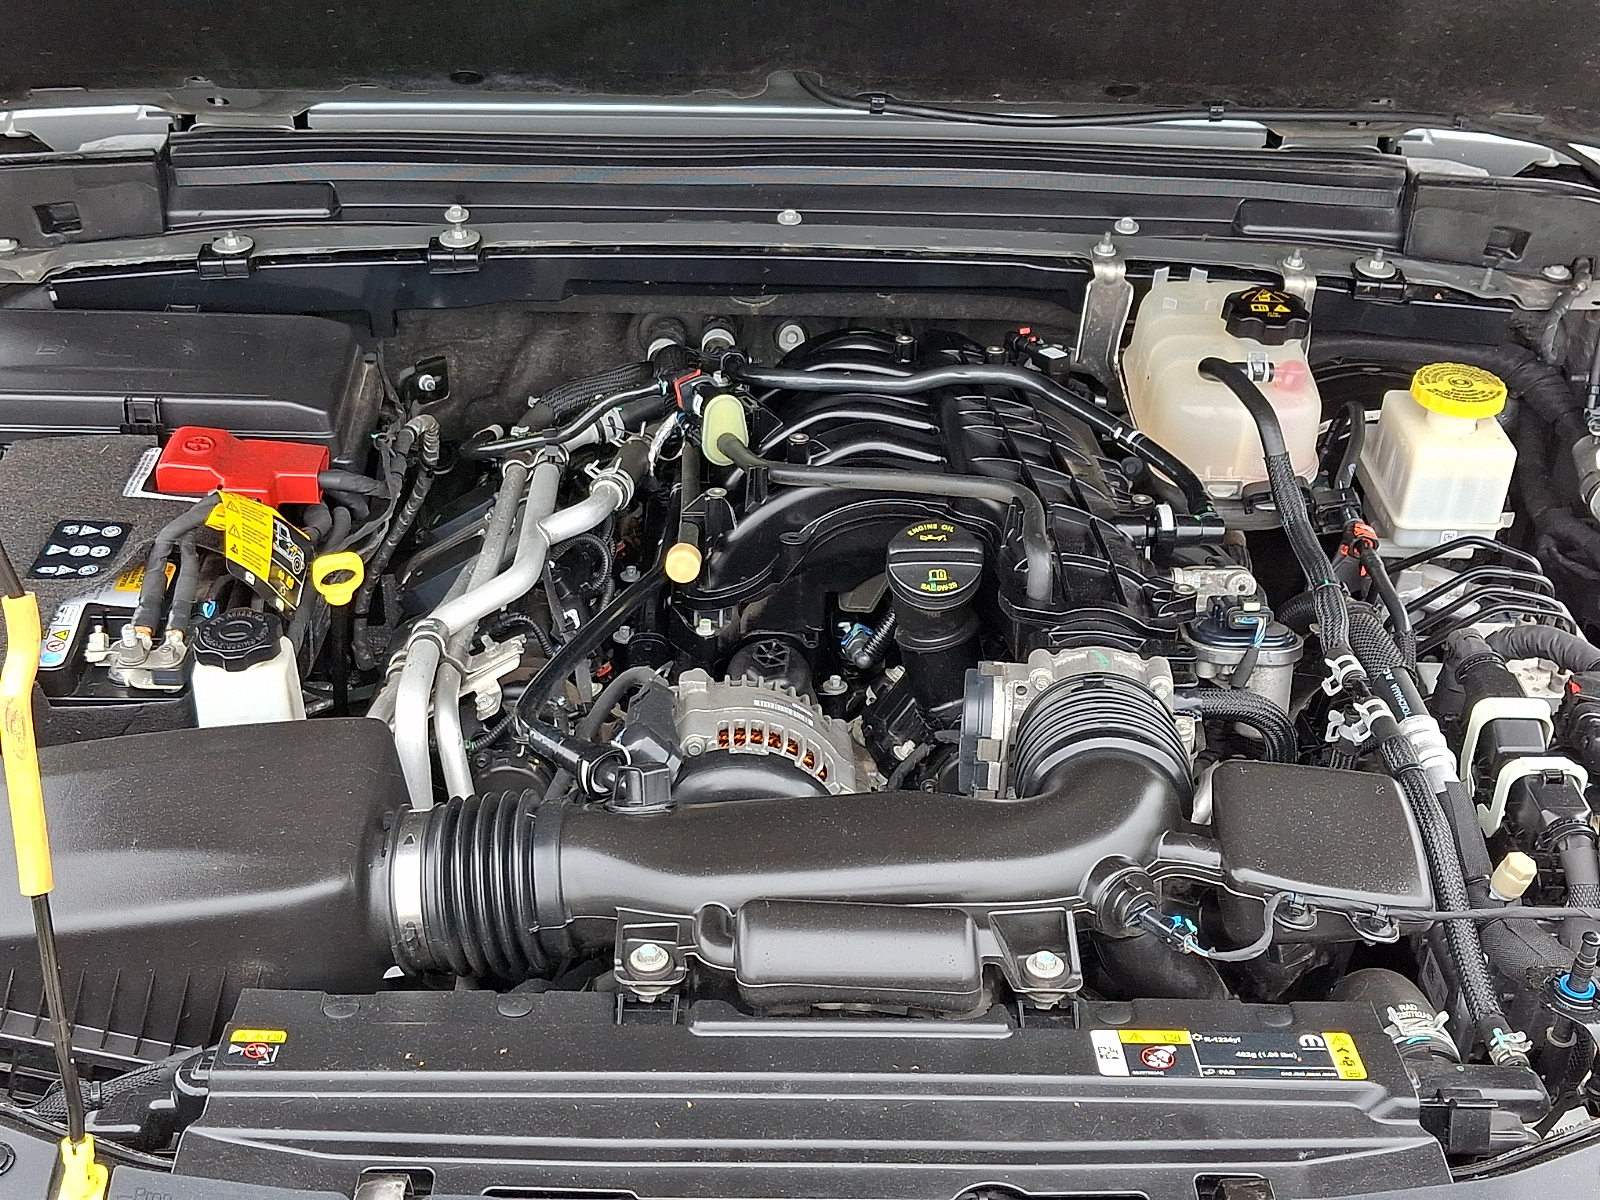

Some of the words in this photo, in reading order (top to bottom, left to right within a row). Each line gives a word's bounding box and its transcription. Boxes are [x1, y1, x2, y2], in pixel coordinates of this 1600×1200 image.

[907, 523, 938, 536] ENGINE
[940, 524, 955, 533] OIL
[1397, 1003, 1418, 1012] RAD
